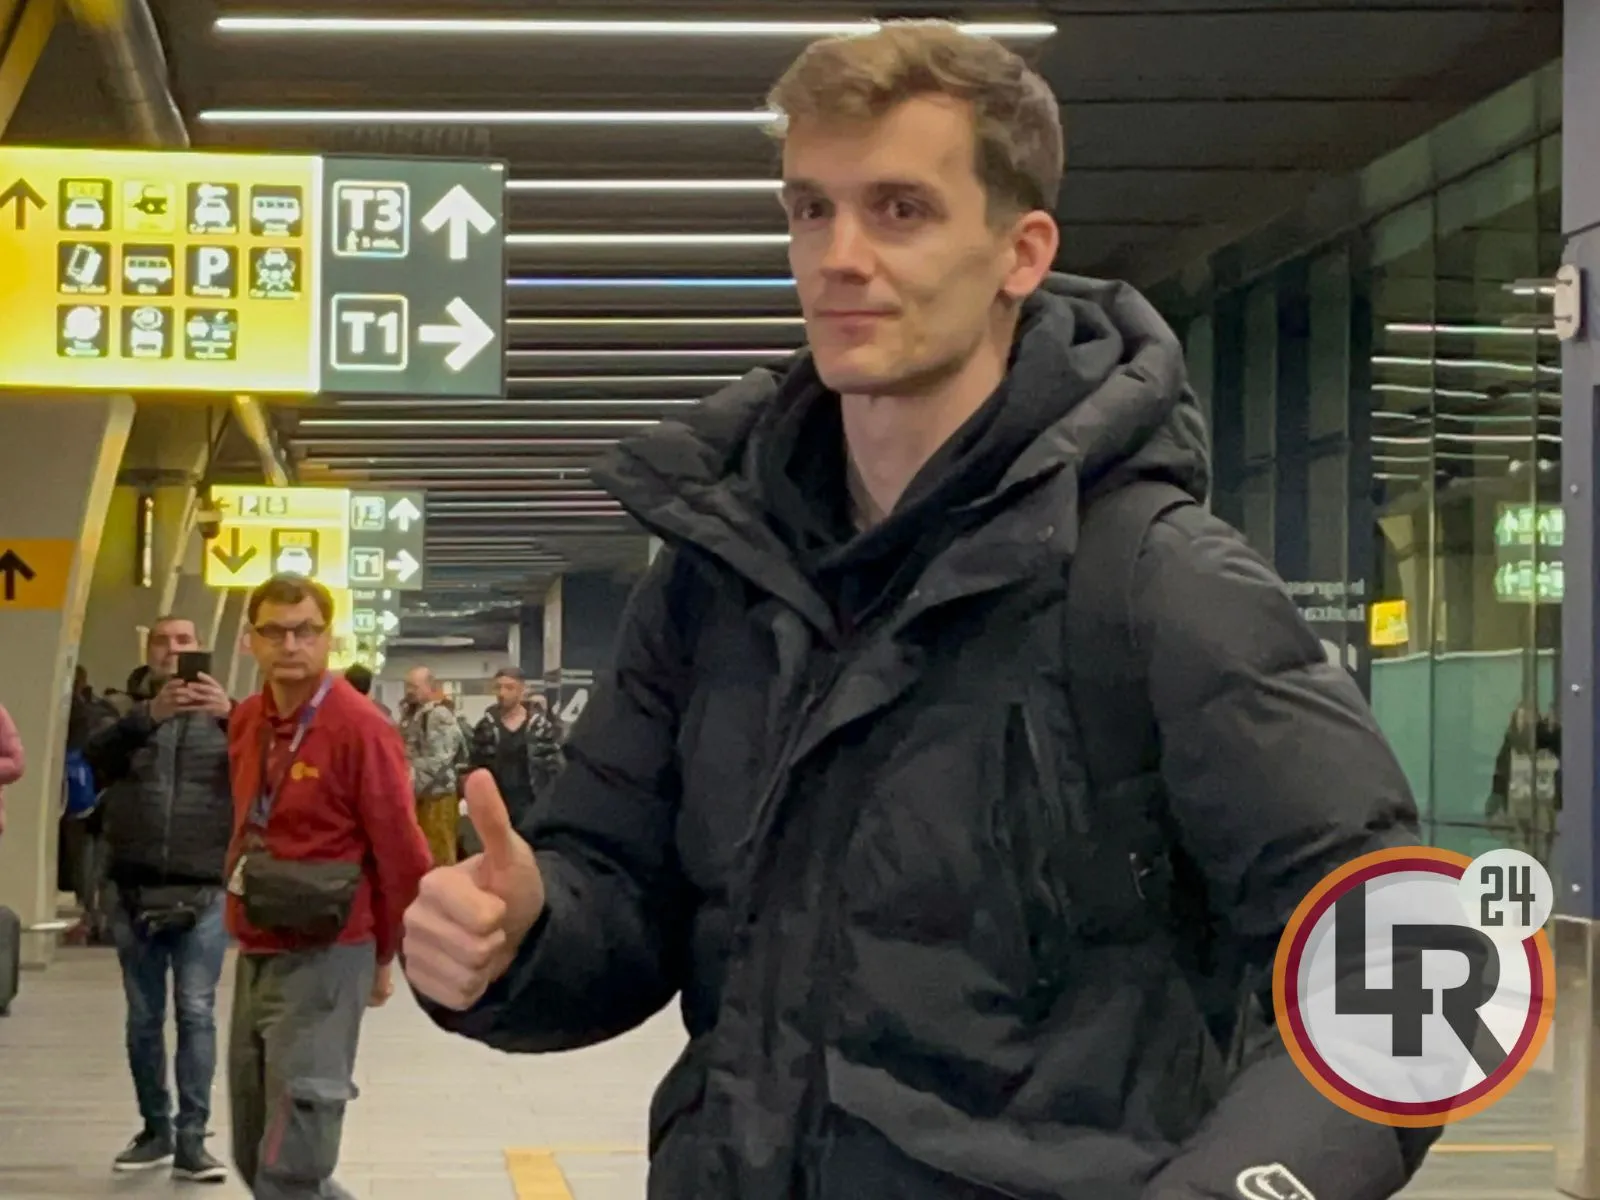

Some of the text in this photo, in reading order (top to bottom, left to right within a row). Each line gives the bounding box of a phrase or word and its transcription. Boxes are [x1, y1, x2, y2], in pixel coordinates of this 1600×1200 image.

[341, 189, 402, 232] T3
[198, 246, 229, 287] P
[342, 311, 398, 354] T1
